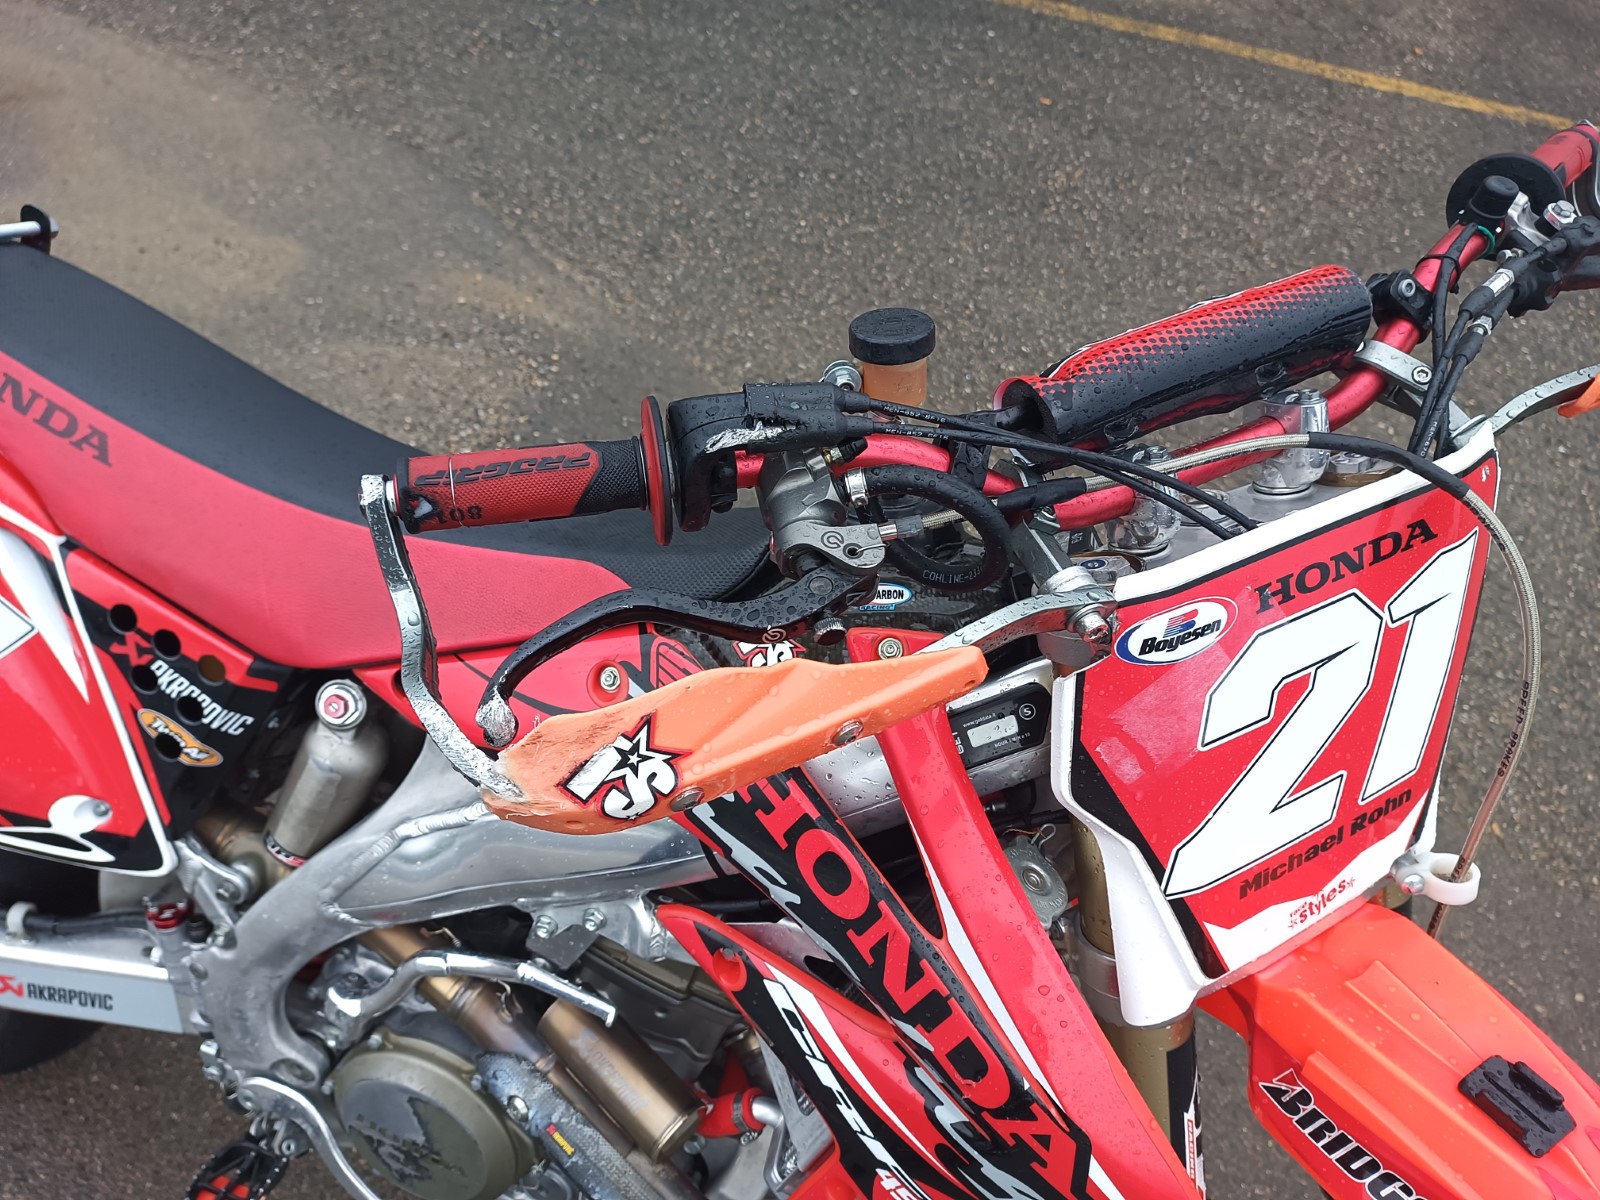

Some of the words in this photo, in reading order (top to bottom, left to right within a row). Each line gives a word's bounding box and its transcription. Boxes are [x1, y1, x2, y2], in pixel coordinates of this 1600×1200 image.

[414, 452, 592, 487] PROGRIP
[1255, 518, 1439, 614] HONDA
[875, 590, 904, 600] ARBON
[1138, 618, 1222, 657] Boyesen
[1160, 526, 1479, 899] 21
[1239, 829, 1344, 899] Michael
[1350, 788, 1412, 838] Rohn
[1300, 879, 1346, 924] styles
[27, 982, 114, 1011] AKRAPOVIC
[735, 777, 1077, 1200] HONDA
